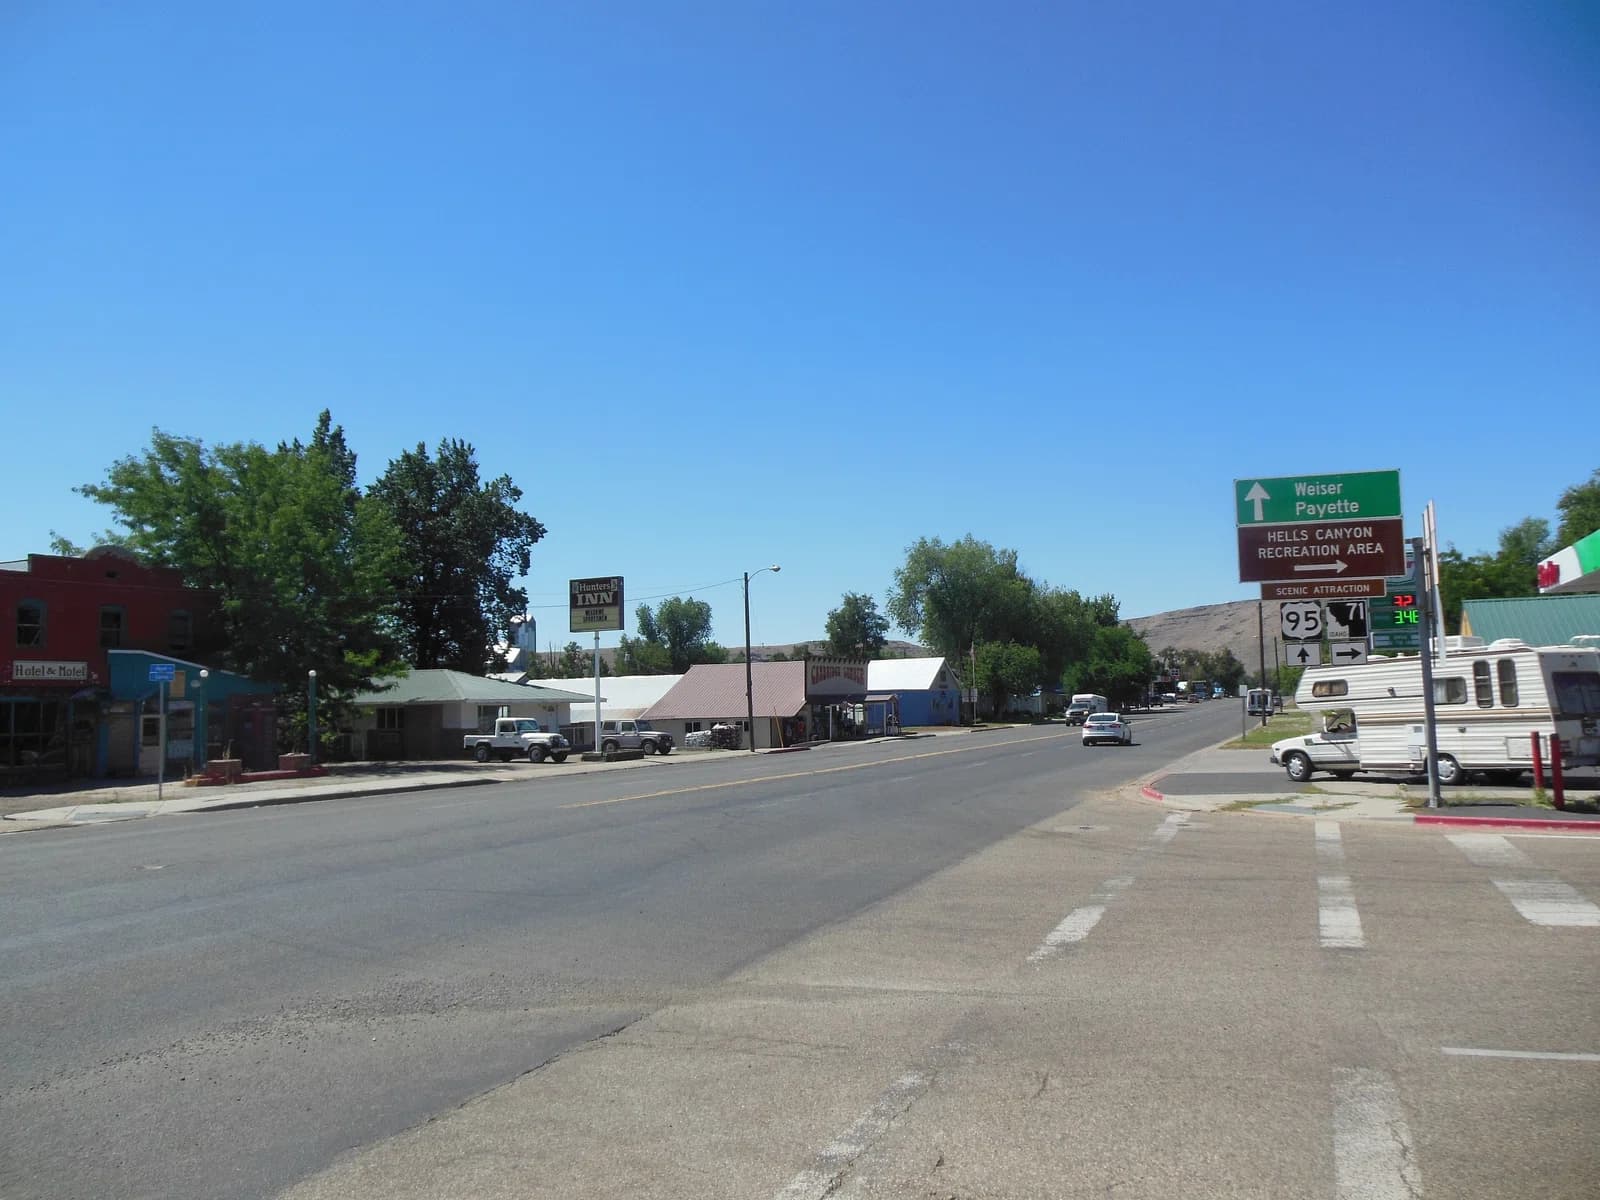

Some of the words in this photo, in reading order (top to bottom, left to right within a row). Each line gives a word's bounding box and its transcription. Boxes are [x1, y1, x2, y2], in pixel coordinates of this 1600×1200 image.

[1294, 482, 1343, 497] Weiser
[1295, 499, 1360, 518] Payette
[1267, 529, 1309, 543] HELLS
[1315, 526, 1373, 540] CANYON
[1258, 545, 1339, 559] RECREATION
[1347, 542, 1384, 555] AREA
[579, 583, 611, 591] Hunters
[1276, 586, 1308, 596] SCENIC
[1313, 584, 1370, 594] ATTRACTION
[577, 592, 613, 605] INN
[1345, 602, 1364, 621] 71
[1286, 610, 1319, 631] 95
[15, 664, 45, 676] Hotel
[47, 666, 56, 675] &
[59, 664, 85, 677] Motel
